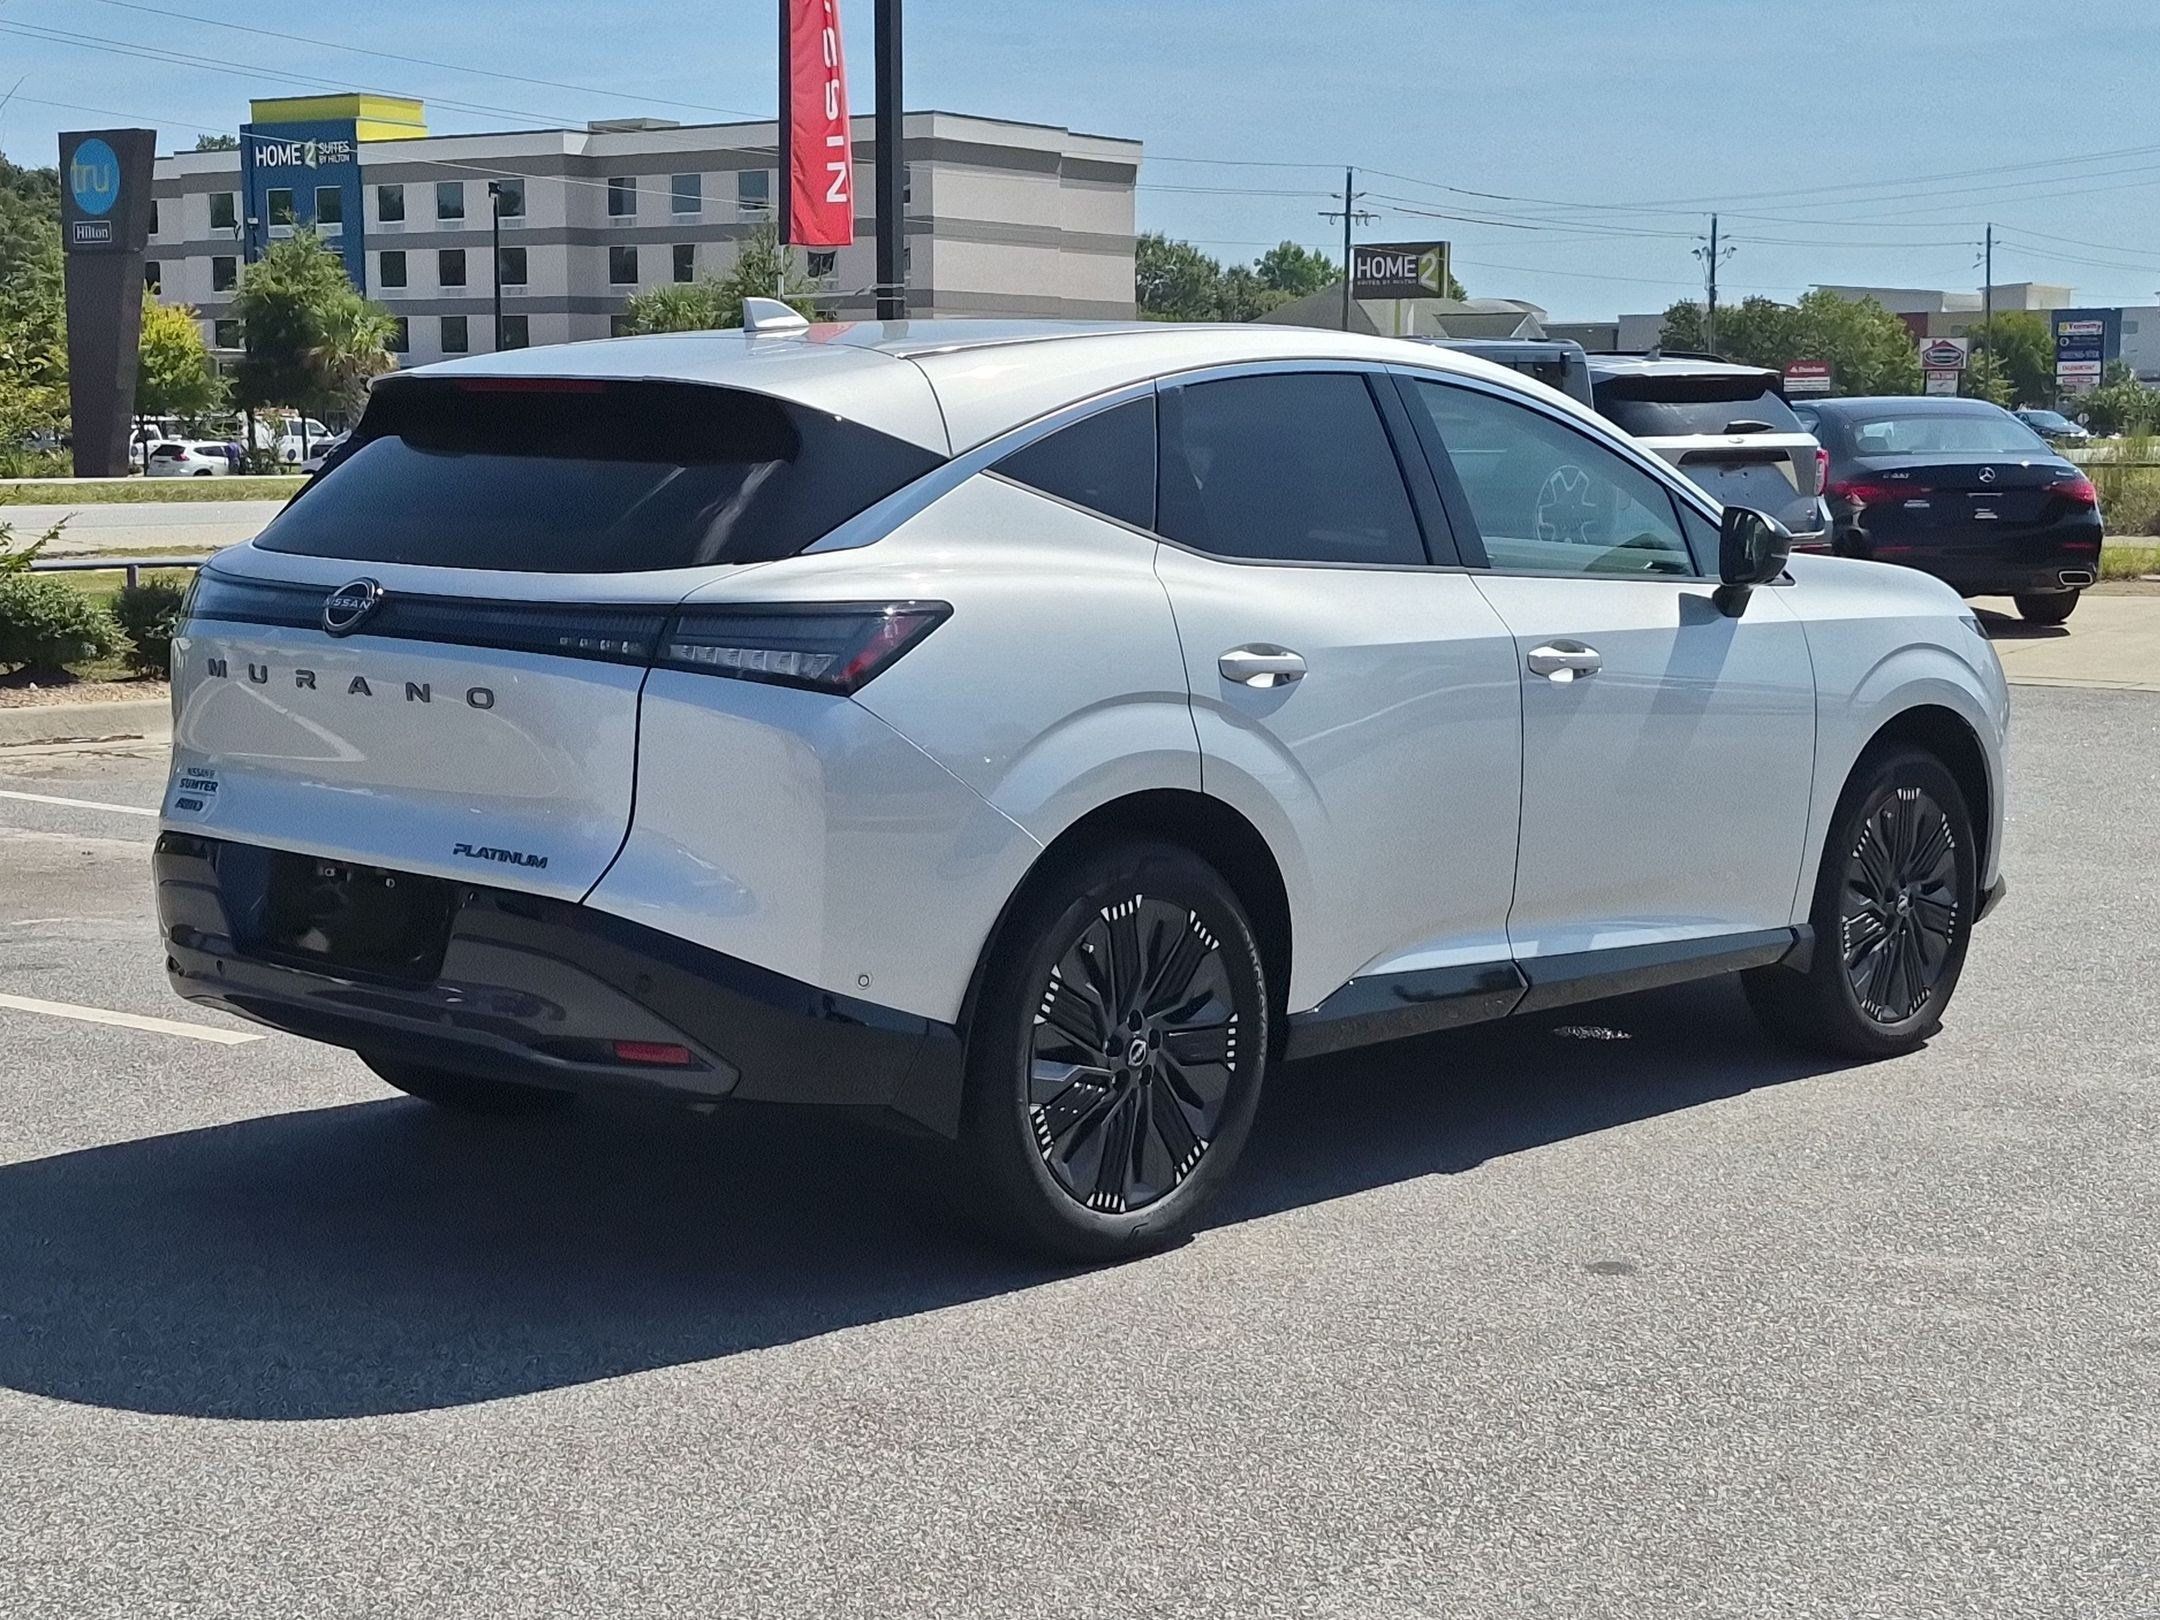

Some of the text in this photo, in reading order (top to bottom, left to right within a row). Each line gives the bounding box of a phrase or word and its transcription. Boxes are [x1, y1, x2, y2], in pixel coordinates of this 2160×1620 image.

[255, 143, 302, 167] HOME
[319, 140, 350, 154] SUITES
[76, 225, 109, 240] Hilton
[1356, 255, 1418, 279] HOME
[207, 657, 495, 710] MURANO
[453, 843, 548, 869] PLATINUM
